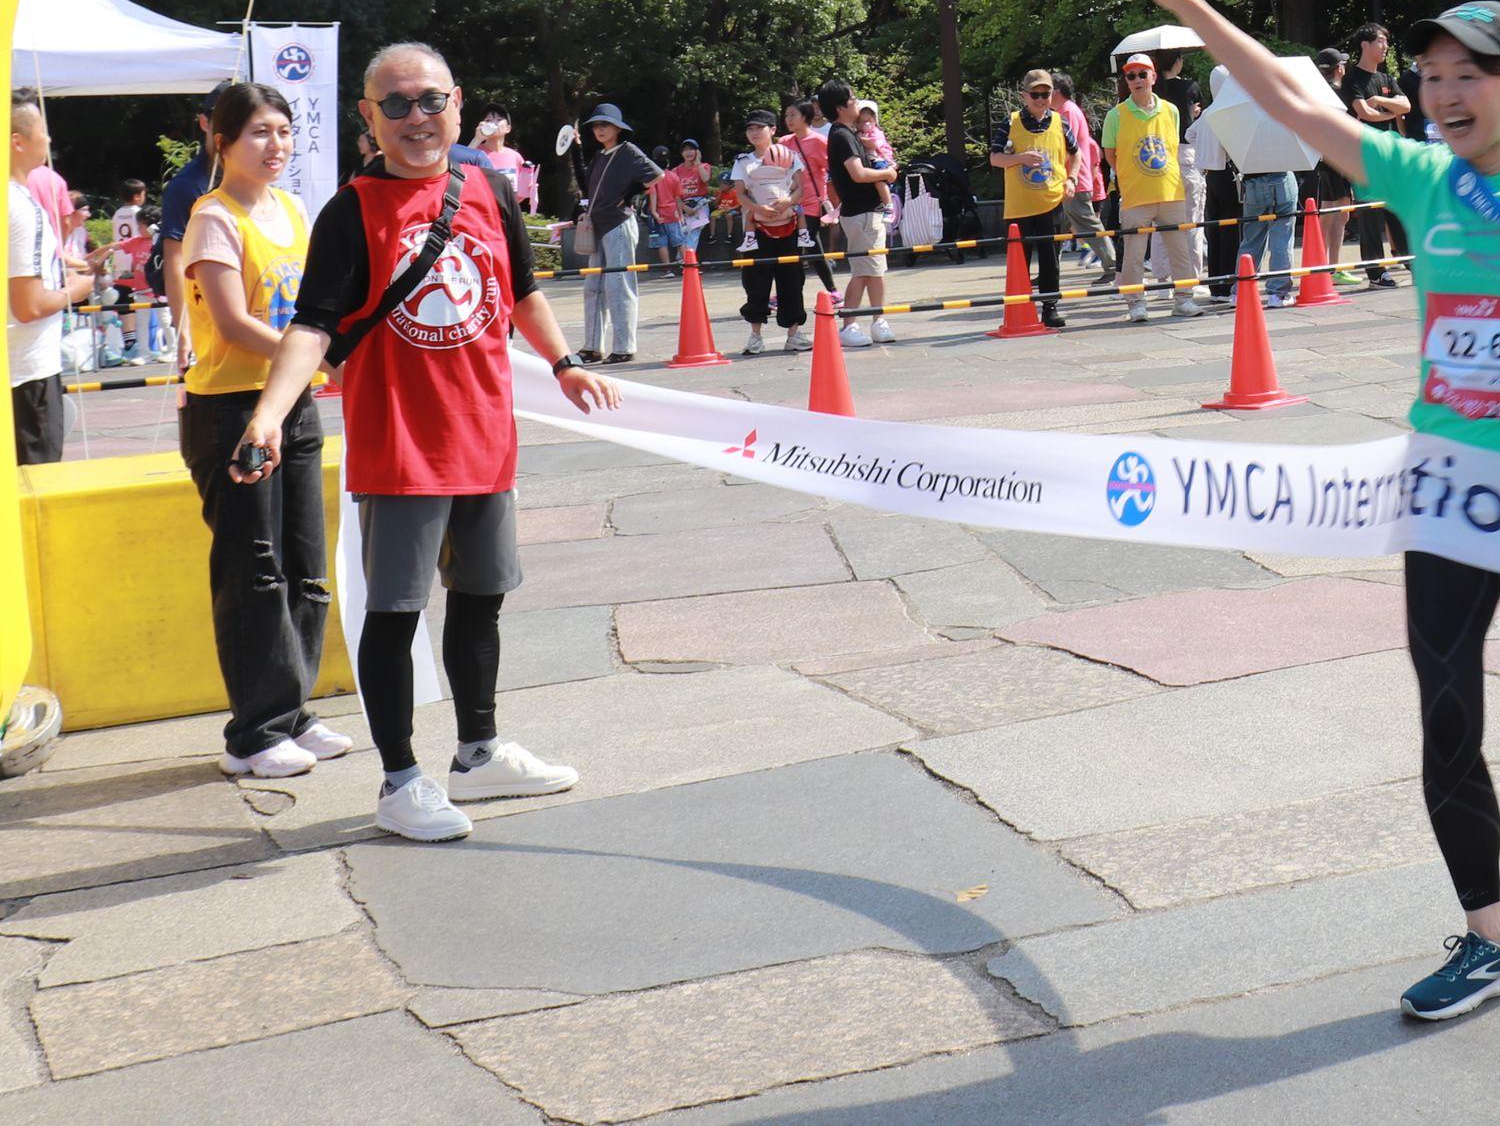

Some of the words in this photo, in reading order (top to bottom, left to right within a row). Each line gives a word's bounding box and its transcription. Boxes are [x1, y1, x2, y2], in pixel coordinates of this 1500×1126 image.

[307, 97, 321, 154] YMCA
[391, 306, 444, 342] national
[448, 306, 491, 341] charity
[485, 276, 497, 304] run
[762, 442, 896, 484] Mitsubishi
[896, 461, 1044, 503] Corporation
[1172, 456, 1295, 526] YMCA
